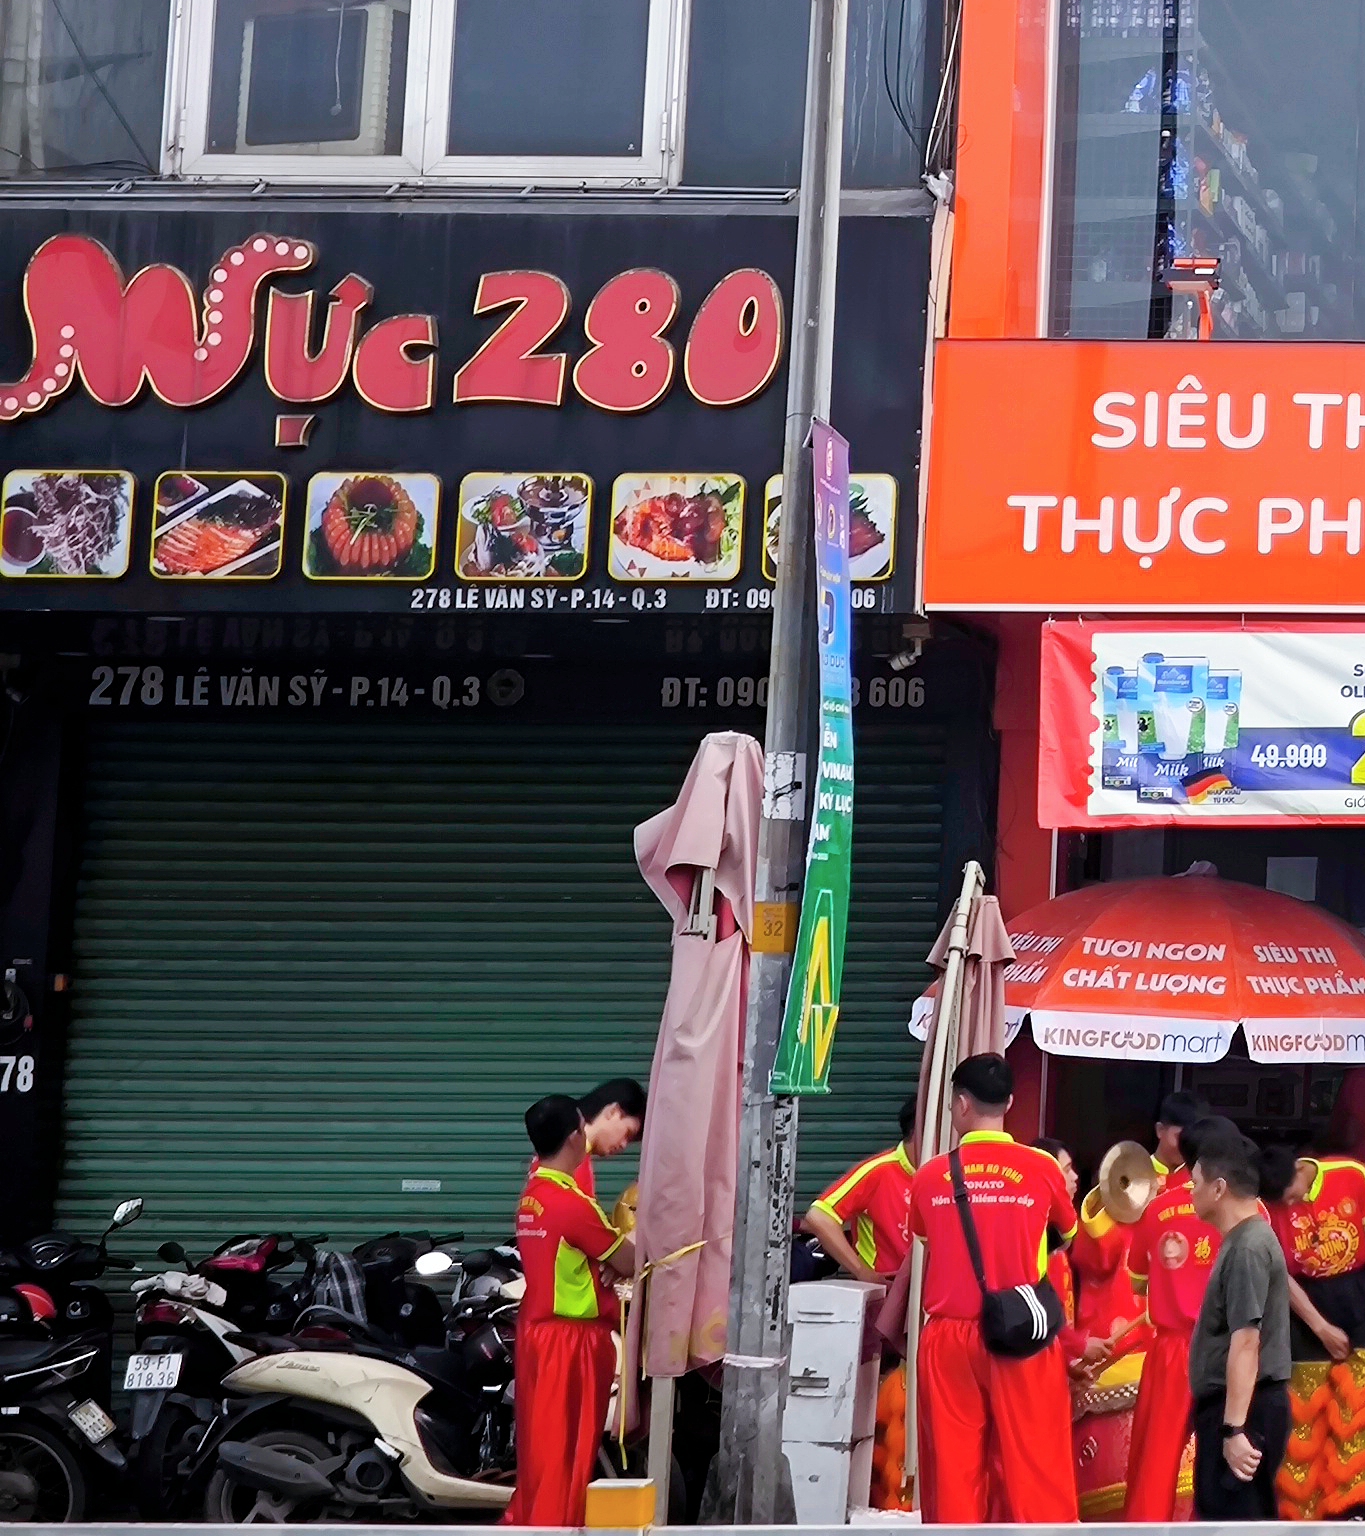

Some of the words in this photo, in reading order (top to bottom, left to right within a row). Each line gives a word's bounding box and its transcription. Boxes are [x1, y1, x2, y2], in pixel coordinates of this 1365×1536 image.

[454, 267, 784, 414] 280
[1091, 375, 1266, 450] SIÊU
[1006, 485, 1228, 569] THỰC
[410, 588, 452, 610] 278
[455, 584, 483, 610] LÊ
[484, 585, 526, 610] VĂN
[530, 586, 559, 610] SỸ
[631, 589, 668, 612] Q.3
[705, 588, 740, 610] ĐT:
[88, 666, 164, 706] 278
[174, 667, 210, 706] LÊ
[220, 668, 279, 706] VĂN
[288, 669, 328, 706] SỸ
[350, 676, 408, 707] P.14
[432, 676, 480, 709] Q.3
[661, 677, 707, 707] ĐT:
[868, 678, 925, 709] 606
[1154, 763, 1189, 777] Milk
[1250, 744, 1328, 769] 49.900
[763, 920, 783, 937] 32
[1081, 935, 1144, 960] TƯƠI
[1146, 941, 1226, 962] NGON
[1253, 940, 1299, 965] SIÊU
[1299, 944, 1334, 967] THỊ
[1062, 966, 1132, 991] CHẤT
[1135, 971, 1227, 997] LƯỢNG
[1246, 973, 1304, 999] THỰC
[134, 1354, 173, 1371] 59-F1
[127, 1371, 175, 1388] 818.36
